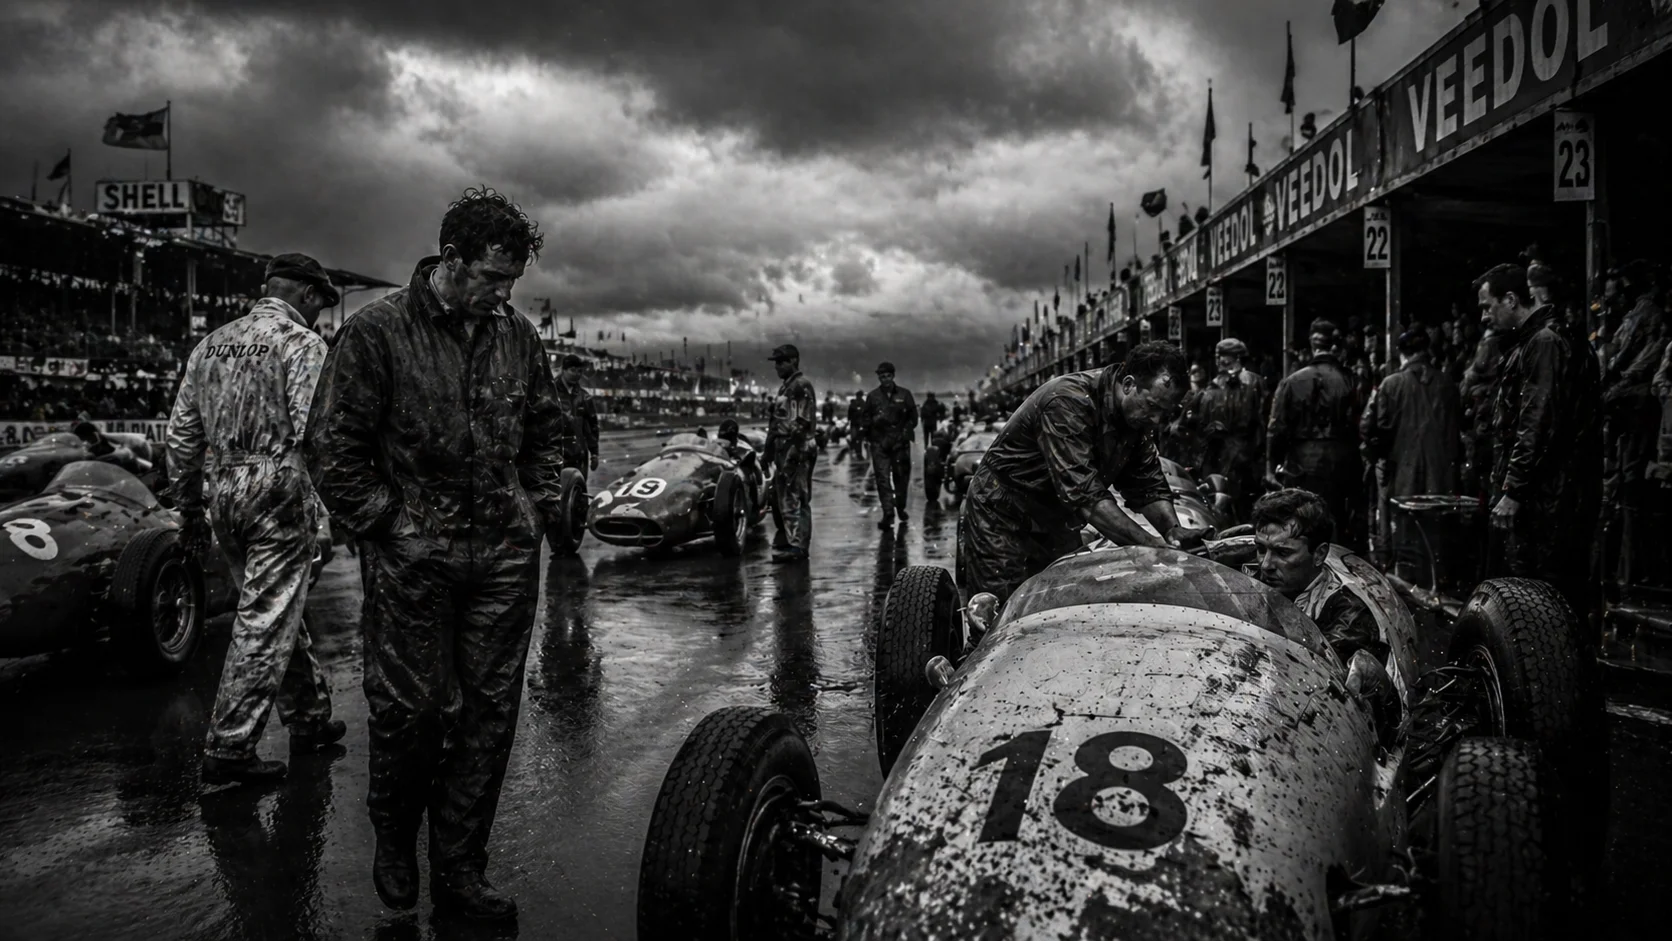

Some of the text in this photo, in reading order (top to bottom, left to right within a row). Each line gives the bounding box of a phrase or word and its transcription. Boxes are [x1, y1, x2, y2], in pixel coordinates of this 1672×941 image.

[1408, 0, 1608, 153] VEEDOL
[1275, 128, 1359, 232] VEEDOL
[1559, 139, 1590, 188] 23
[104, 184, 184, 209] SHELL
[1209, 199, 1257, 269] VEEDOL
[1366, 226, 1388, 260] 22
[205, 344, 270, 359] DUNLOP
[2, 518, 58, 561] 8
[970, 729, 1188, 851] 18
